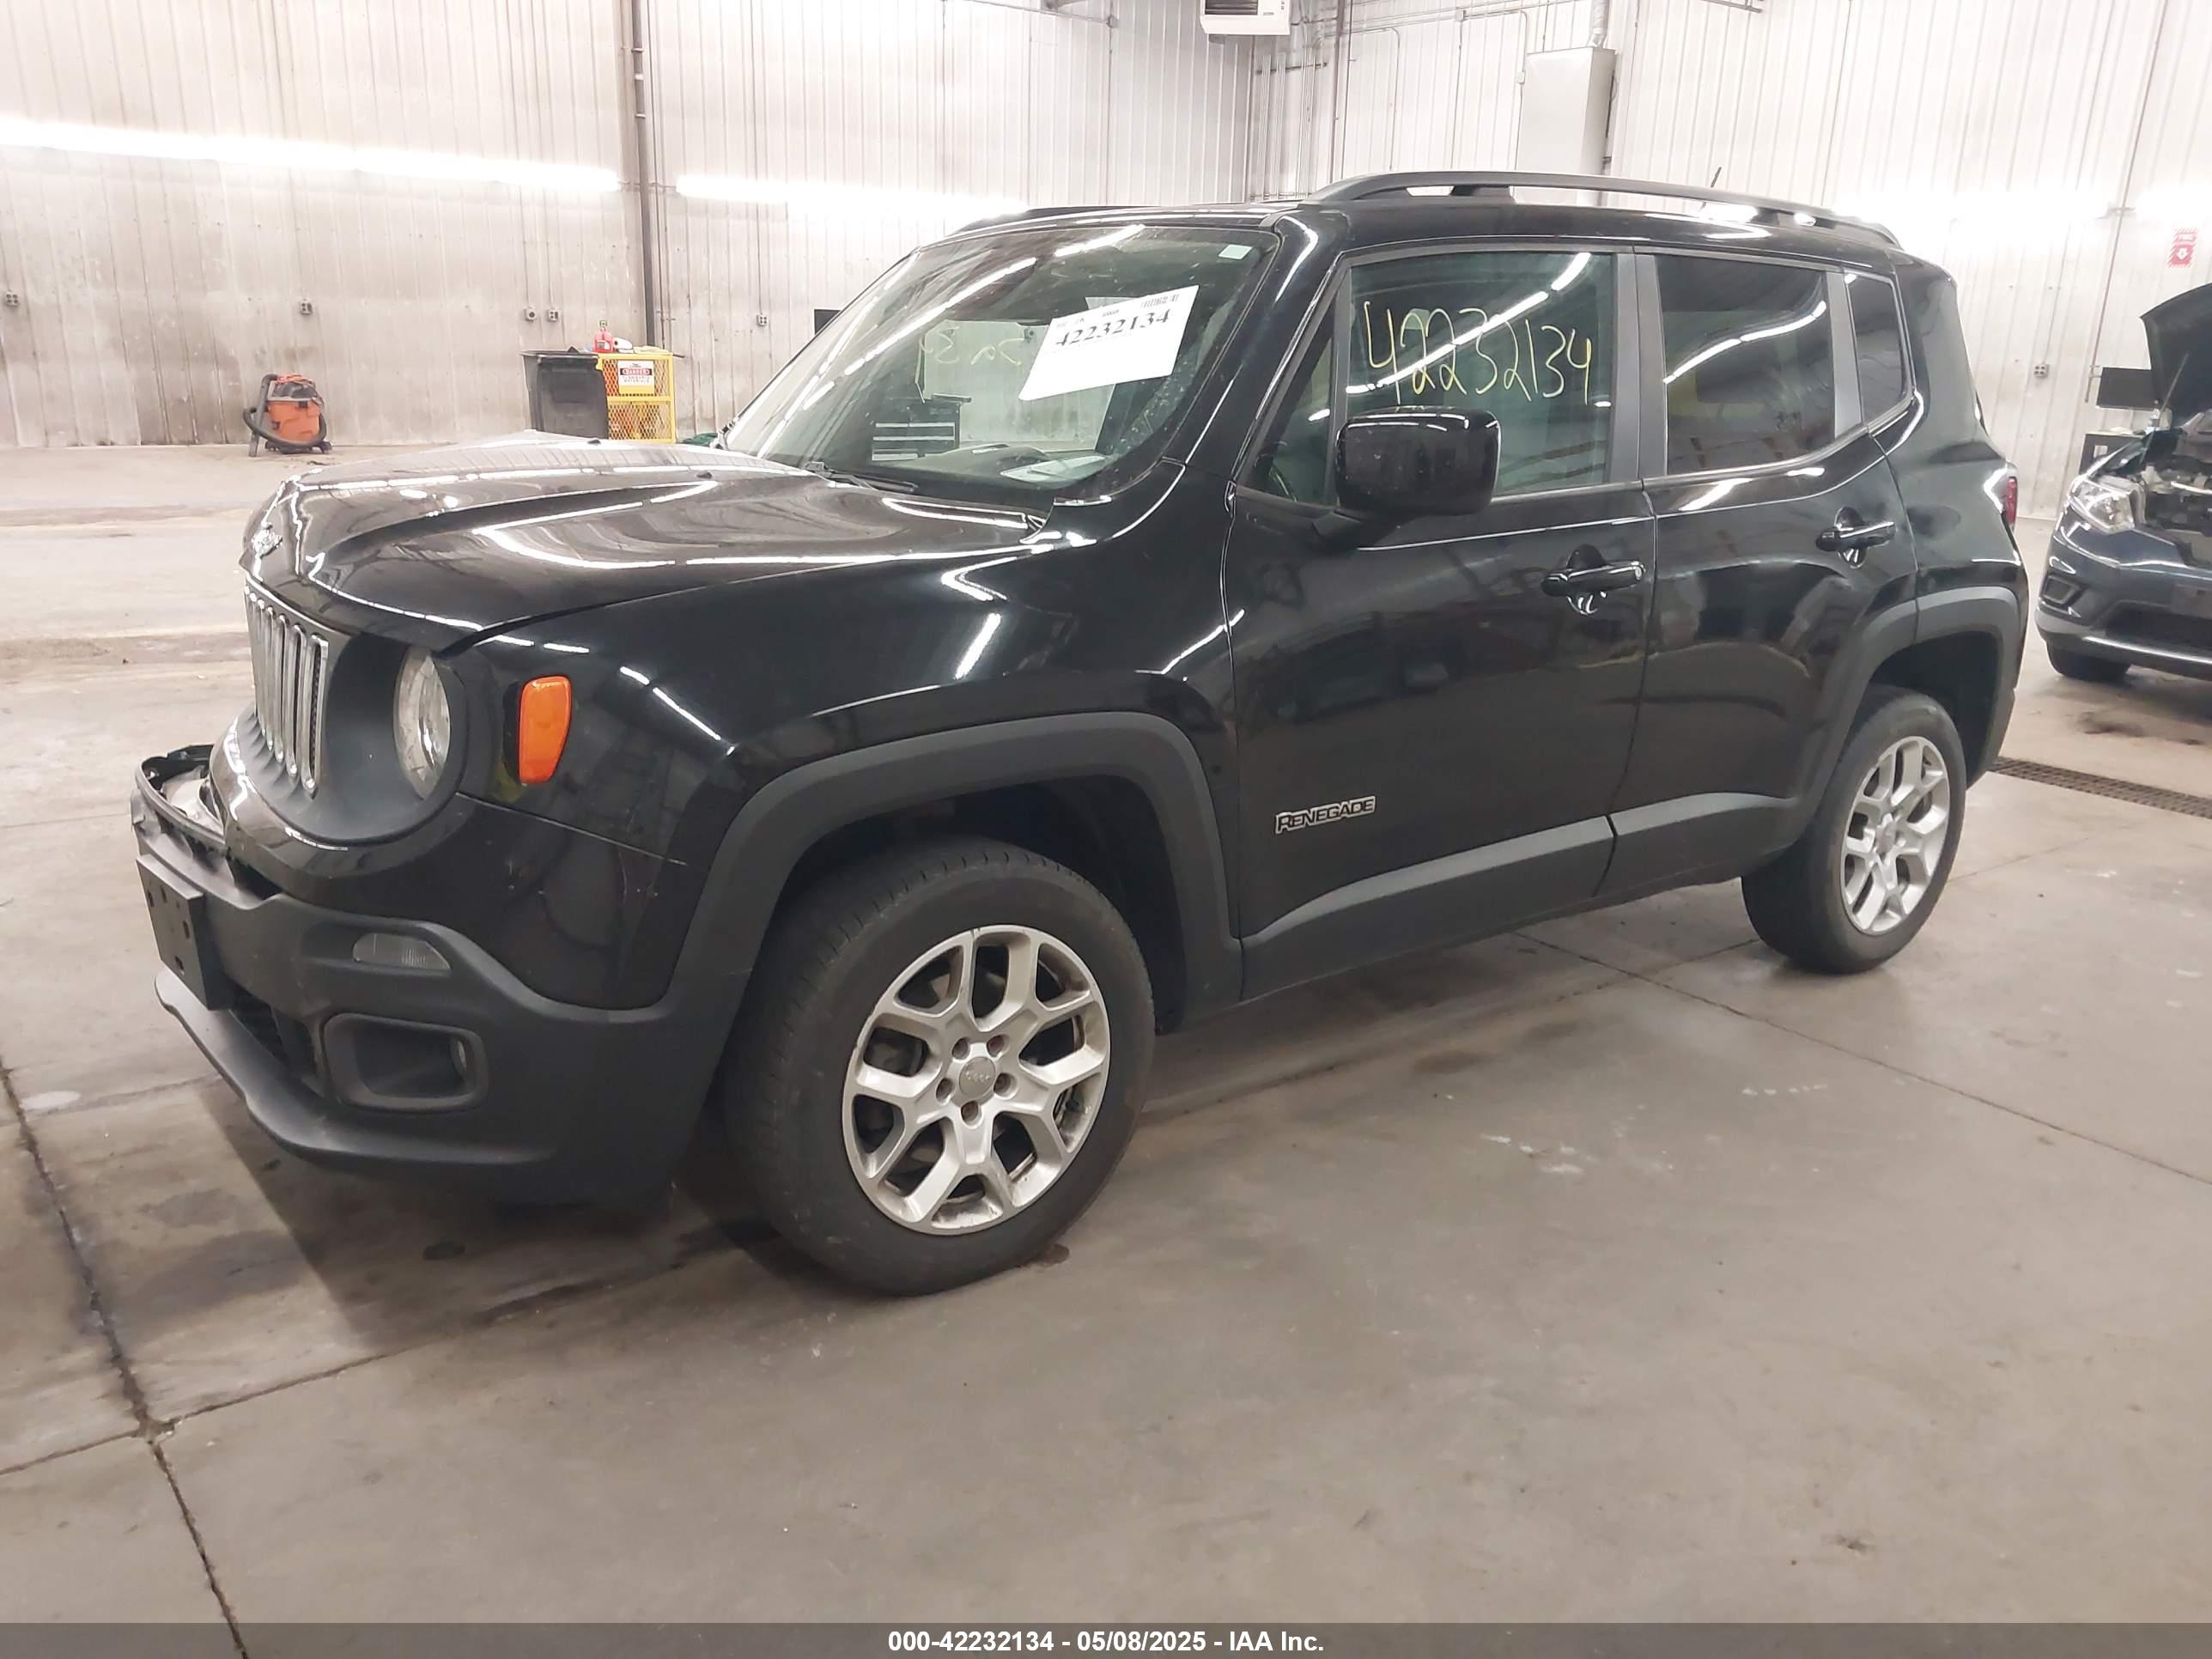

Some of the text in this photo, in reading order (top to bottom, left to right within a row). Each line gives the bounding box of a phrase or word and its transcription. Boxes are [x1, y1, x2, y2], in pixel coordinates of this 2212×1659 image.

[1055, 308, 1171, 347] 42232134
[1364, 301, 1592, 406] 42232134
[1275, 795, 1376, 834] RENEGADE
